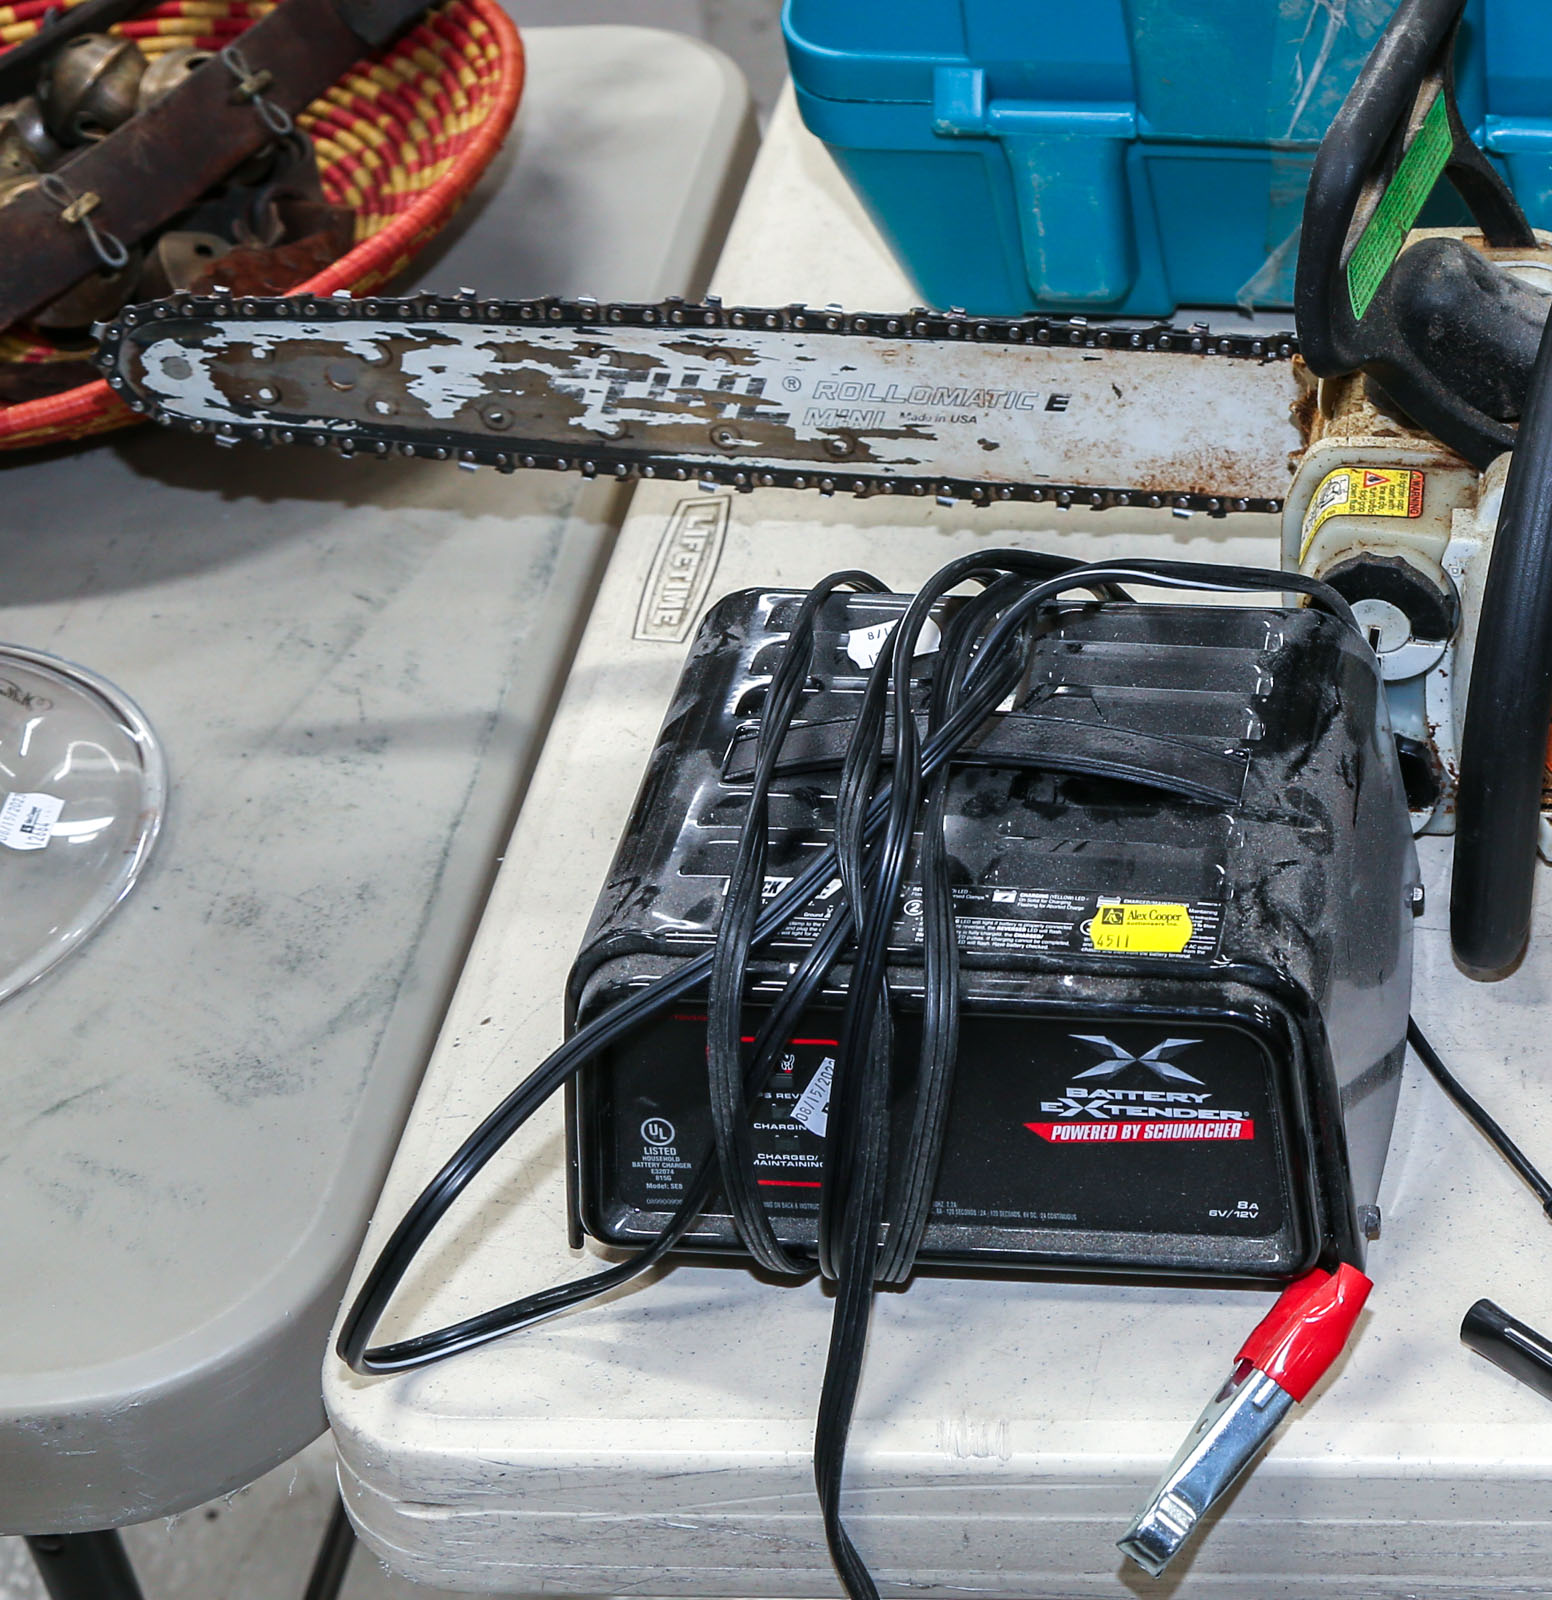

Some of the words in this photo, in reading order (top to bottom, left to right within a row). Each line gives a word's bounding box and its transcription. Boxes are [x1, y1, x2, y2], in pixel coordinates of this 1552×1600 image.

[812, 380, 1040, 411] ROLLOMATIC
[1044, 392, 1073, 413] E
[802, 407, 886, 429] MINI
[933, 413, 947, 424] in
[949, 413, 979, 425] USA
[650, 513, 716, 627] LIFETIME
[1127, 909, 1147, 921] Alex
[1149, 909, 1182, 924] Cooper
[1097, 935, 1129, 948] 4511
[1065, 1086, 1213, 1104] BATTERY
[648, 1123, 668, 1140] UL
[753, 1122, 808, 1131] CHARGIN
[1051, 1124, 1118, 1141] POWERED
[1120, 1124, 1141, 1140] BY
[1143, 1122, 1242, 1140] SCHUMACHER
[643, 1146, 677, 1156] LISTED
[757, 1153, 819, 1161] CHARGED/
[646, 1182, 670, 1190] Model:
[1237, 1200, 1260, 1210] 8A
[1208, 1209, 1260, 1219] 6V/12V
